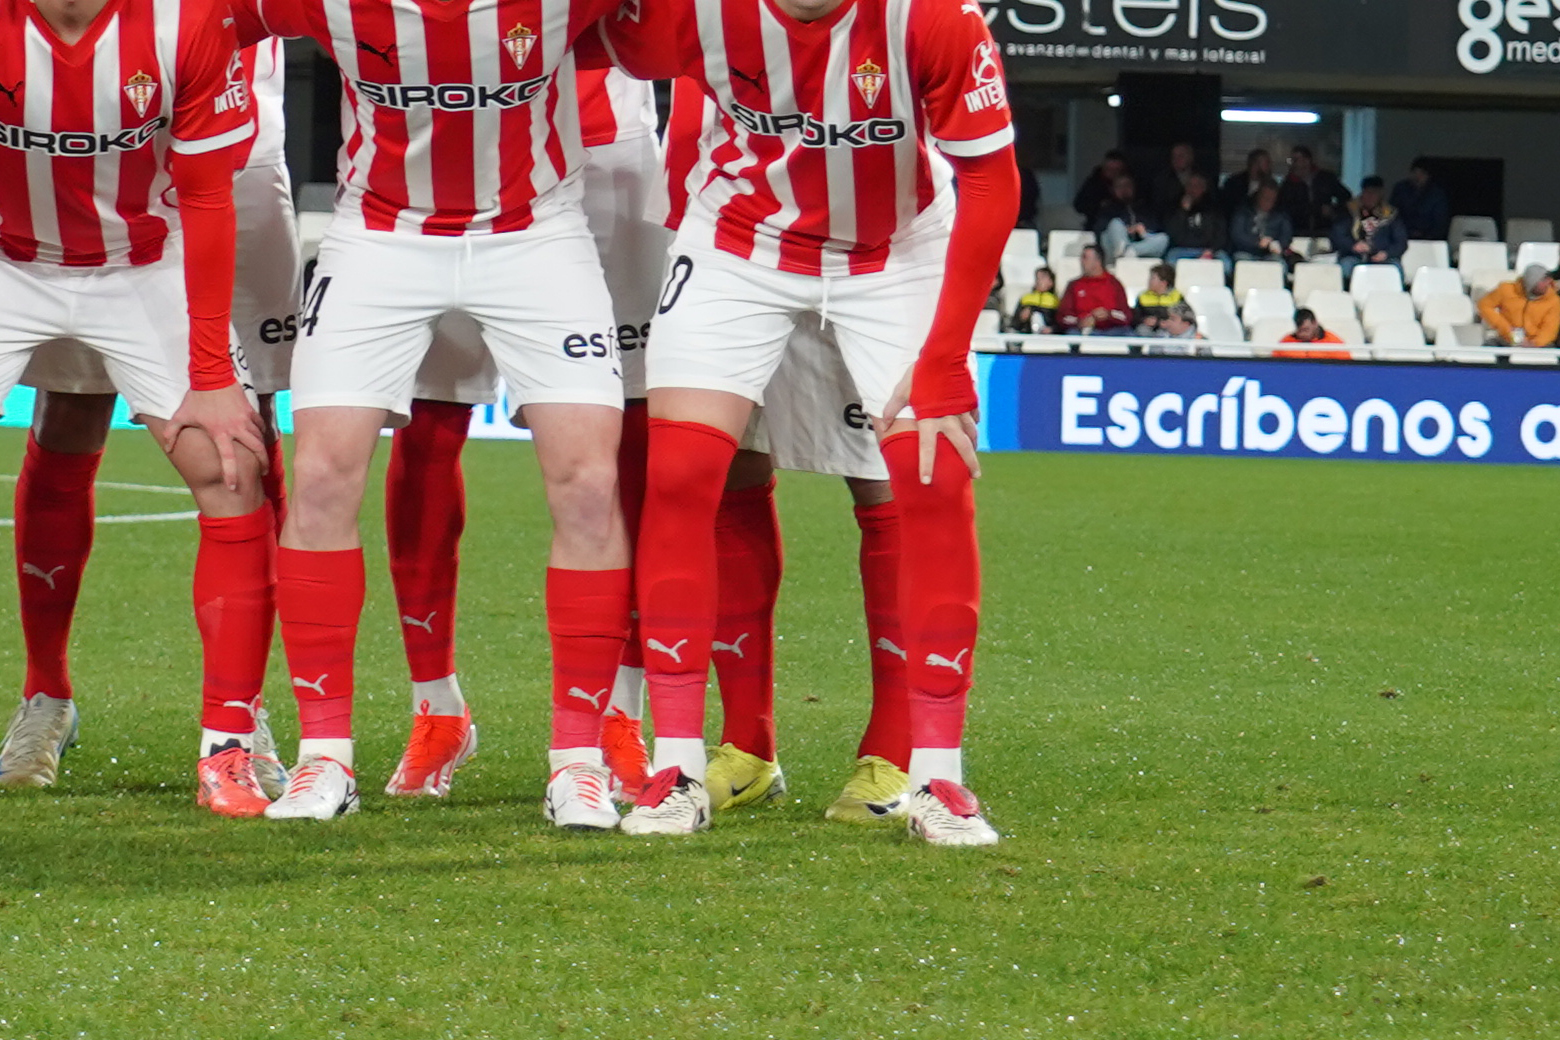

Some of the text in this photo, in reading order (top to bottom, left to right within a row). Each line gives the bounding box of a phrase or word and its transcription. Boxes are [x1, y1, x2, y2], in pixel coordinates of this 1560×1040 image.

[354, 74, 552, 111] SIROKO
[730, 102, 907, 147] SIROKO
[1061, 376, 1493, 458] Escríbenos
